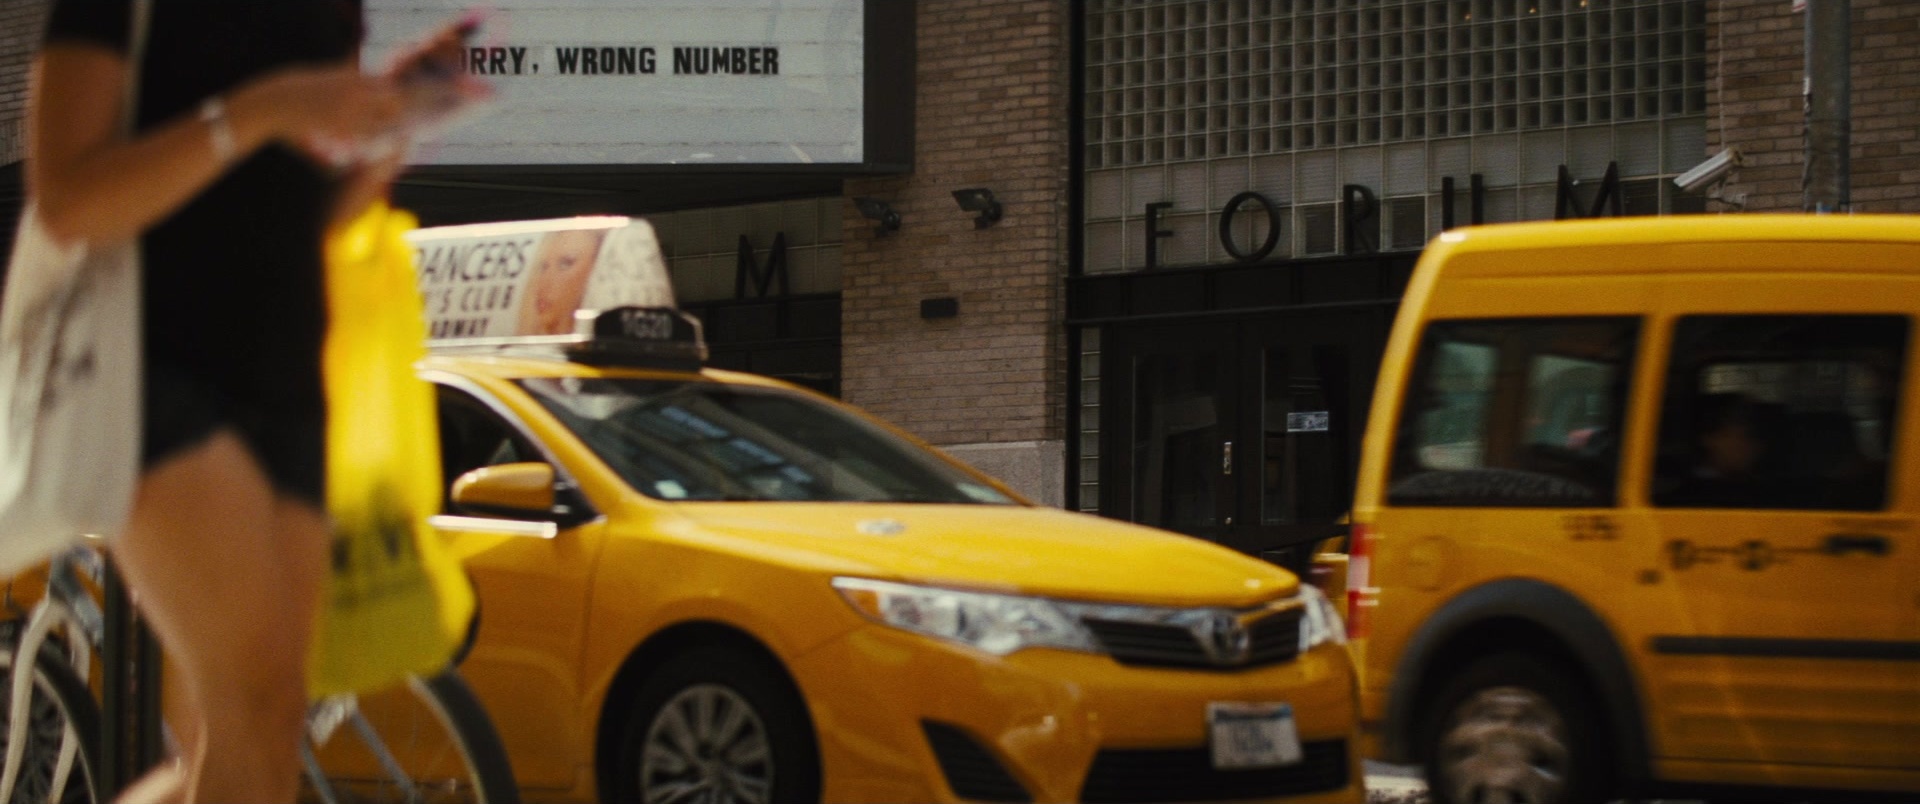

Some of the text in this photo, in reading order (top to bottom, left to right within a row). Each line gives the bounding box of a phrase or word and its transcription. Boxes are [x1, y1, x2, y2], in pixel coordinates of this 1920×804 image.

[556, 47, 656, 74] WRONG
[673, 47, 779, 74] NUMBER
[459, 284, 516, 311] CLUB
